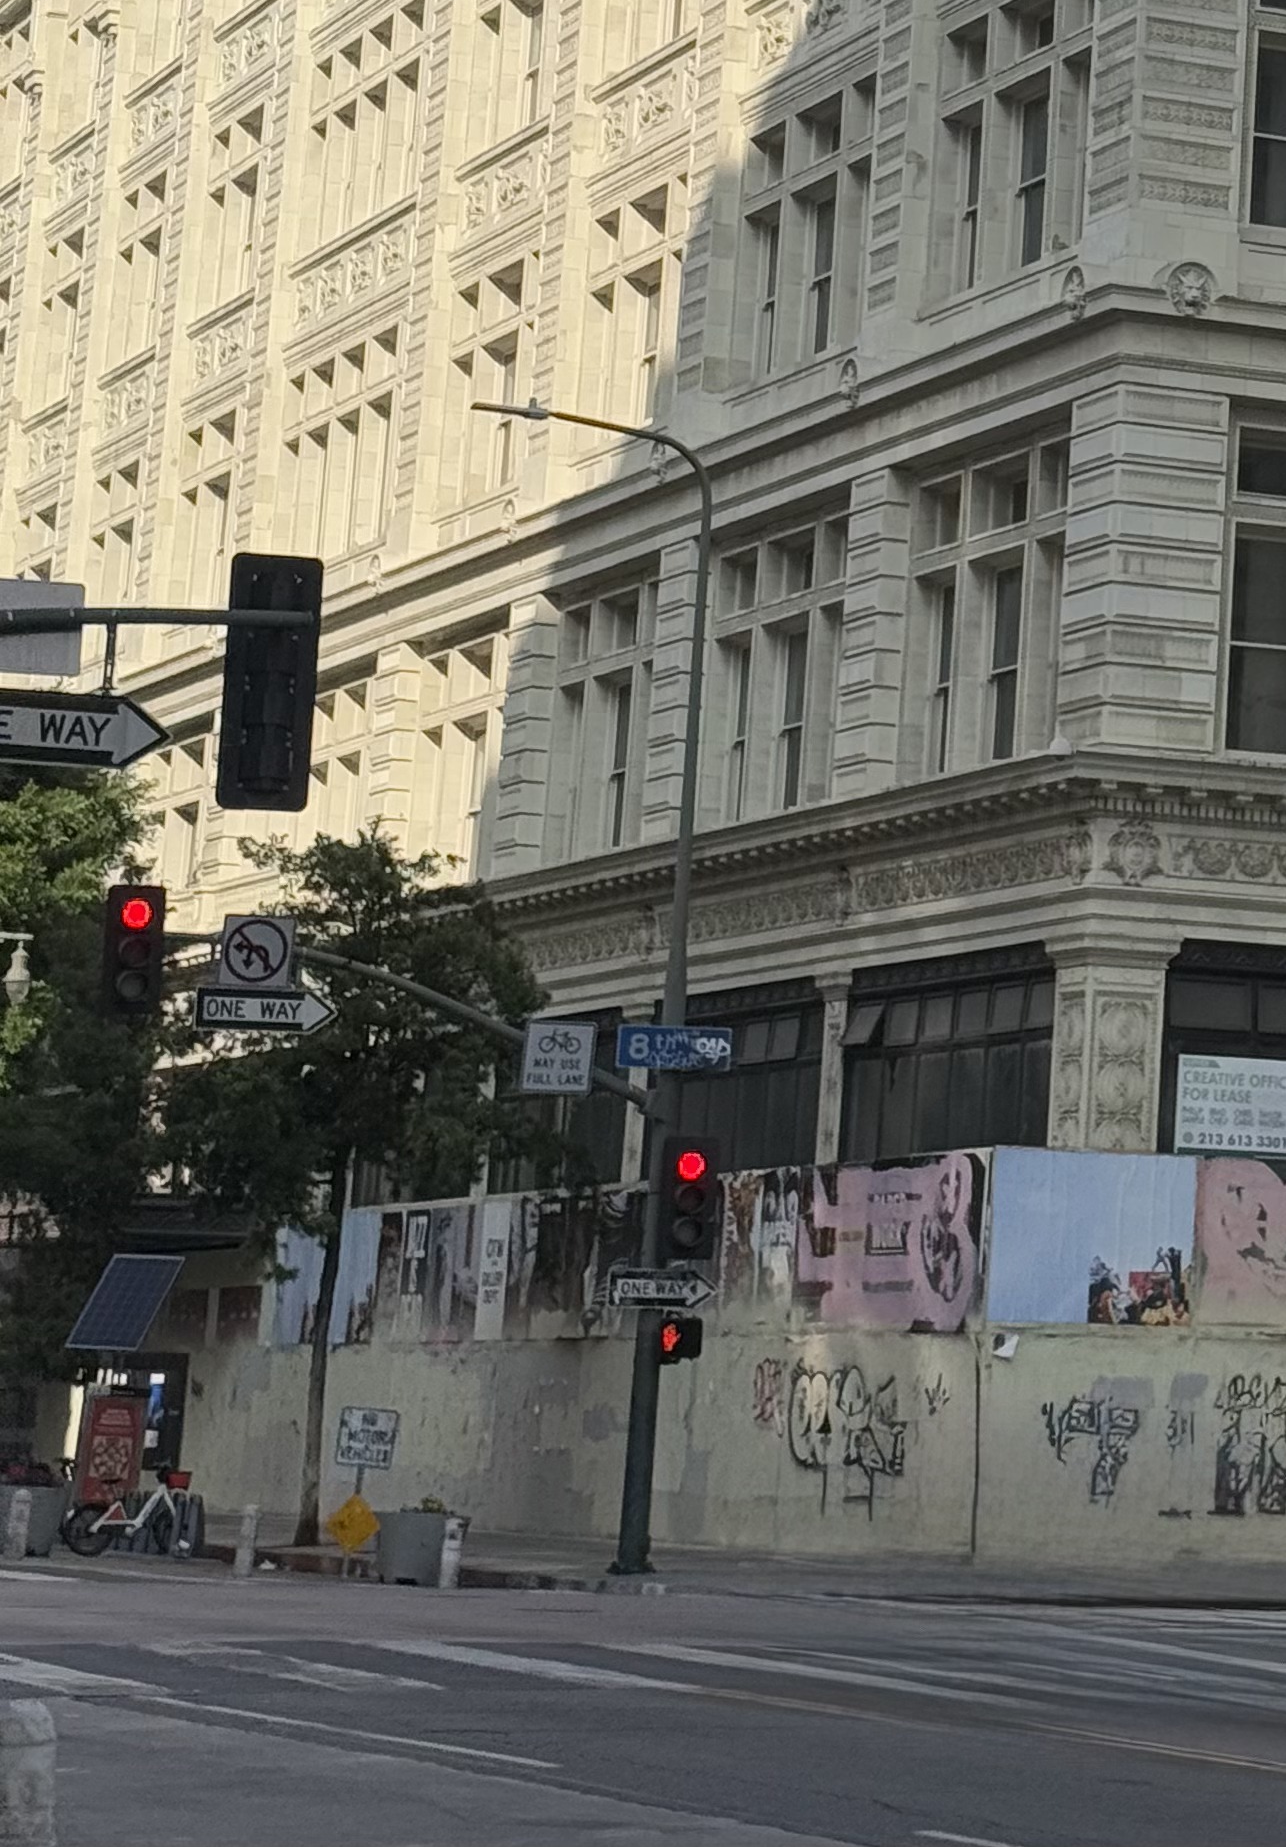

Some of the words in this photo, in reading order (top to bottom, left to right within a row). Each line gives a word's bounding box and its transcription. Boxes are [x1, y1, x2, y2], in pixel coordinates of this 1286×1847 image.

[39, 712, 112, 747] WAY
[206, 998, 246, 1019] ONE
[260, 1000, 302, 1021] WAY
[533, 1058, 555, 1070] MAY
[561, 1058, 582, 1071] USE
[526, 1072, 551, 1084] FULL
[558, 1074, 585, 1086] LANE
[1183, 1070, 1246, 1087] CREATIVE
[1182, 1086, 1210, 1101] FOR
[1213, 1088, 1253, 1104] LEASE
[1198, 1132, 1224, 1147] 213
[1227, 1134, 1253, 1148] 613
[621, 1280, 650, 1295] ONE
[656, 1281, 685, 1296] WAY
